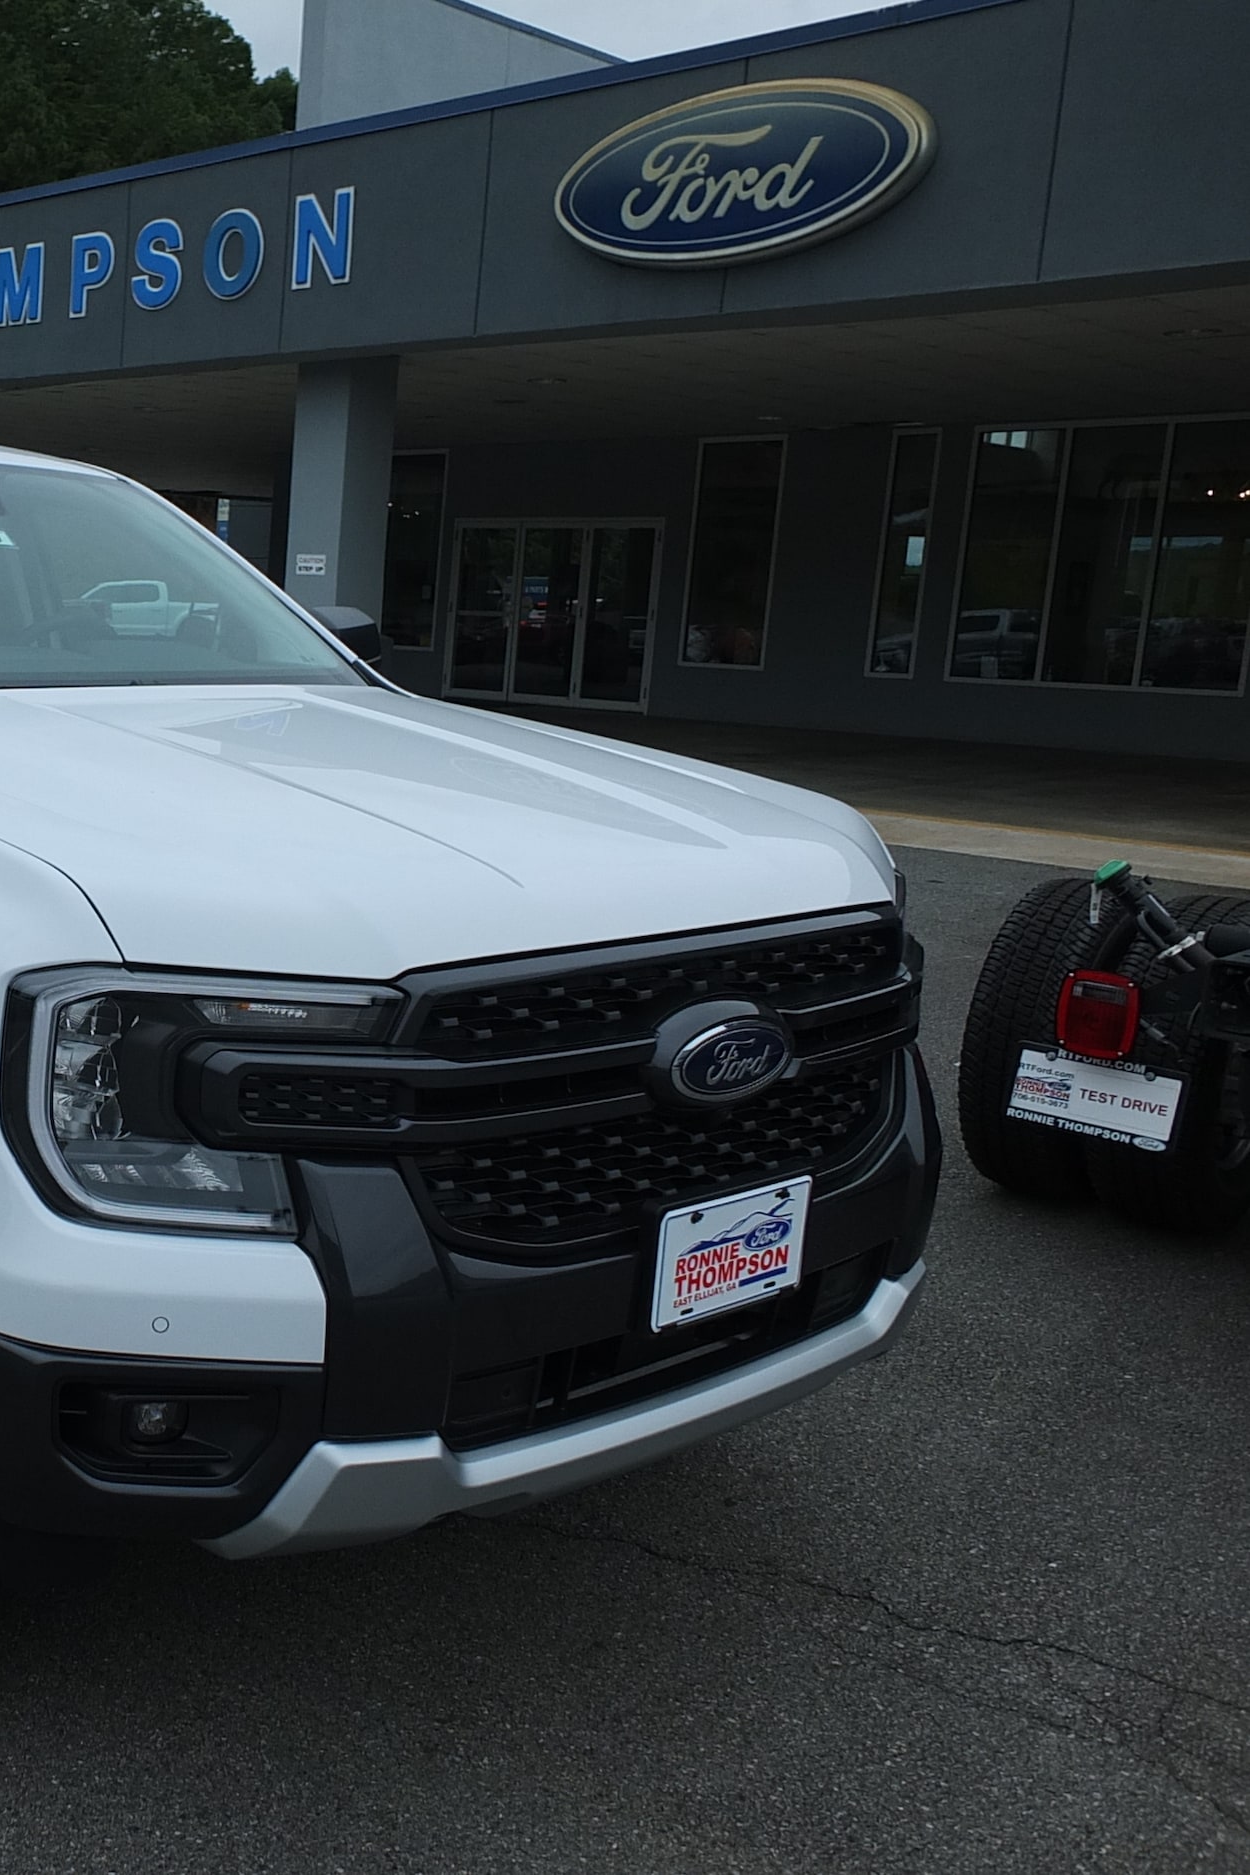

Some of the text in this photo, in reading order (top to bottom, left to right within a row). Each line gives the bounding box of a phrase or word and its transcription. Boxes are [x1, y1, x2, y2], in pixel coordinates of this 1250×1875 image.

[621, 124, 824, 231] Ford
[706, 1038, 770, 1085] Ford
[1015, 1082, 1070, 1100] THOMPSON
[1079, 1087, 1169, 1117] TEST DRIVE
[1006, 1107, 1054, 1126] RONNIE
[1056, 1118, 1132, 1144] THOMPSON
[750, 1220, 783, 1248] Ford
[674, 1244, 790, 1298] THOMPSON
[675, 1242, 741, 1276] RONNIE
[673, 1295, 693, 1309] EAST
[726, 1282, 736, 1292] GA
